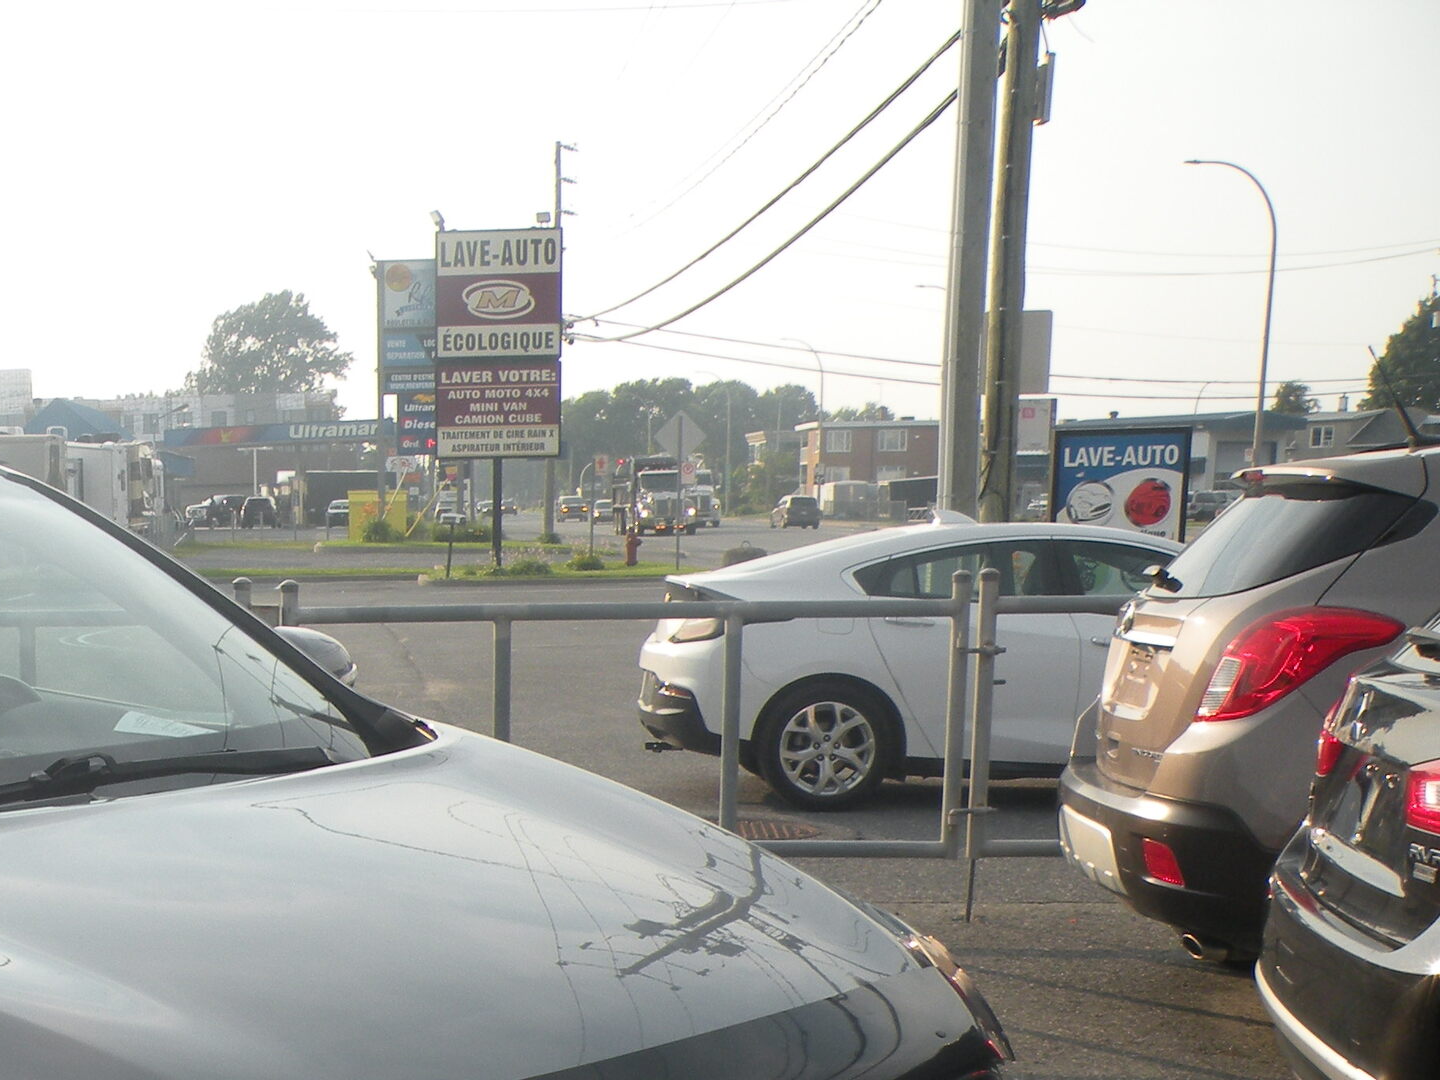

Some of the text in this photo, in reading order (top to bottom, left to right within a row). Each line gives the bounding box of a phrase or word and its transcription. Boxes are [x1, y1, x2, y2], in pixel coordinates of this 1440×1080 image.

[440, 238, 556, 268] LAVE-AUTO
[476, 290, 520, 309] M
[442, 328, 554, 352] ÉCOLOGIQUE
[441, 369, 556, 384] LAVER VOTRE:
[448, 388, 549, 400] AUTO MOTO 4X4
[469, 402, 527, 412] MINI VAN
[455, 414, 542, 424] CAMION CUBE
[289, 424, 378, 439] Ultramar
[442, 431, 490, 440] TRAITEMENT
[493, 430, 503, 438] DE
[506, 430, 525, 438] CIRE
[527, 429, 547, 438] RAIN
[451, 443, 500, 452] ASPIRATEUR
[1063, 445, 1179, 468] LAVE-AUTO
